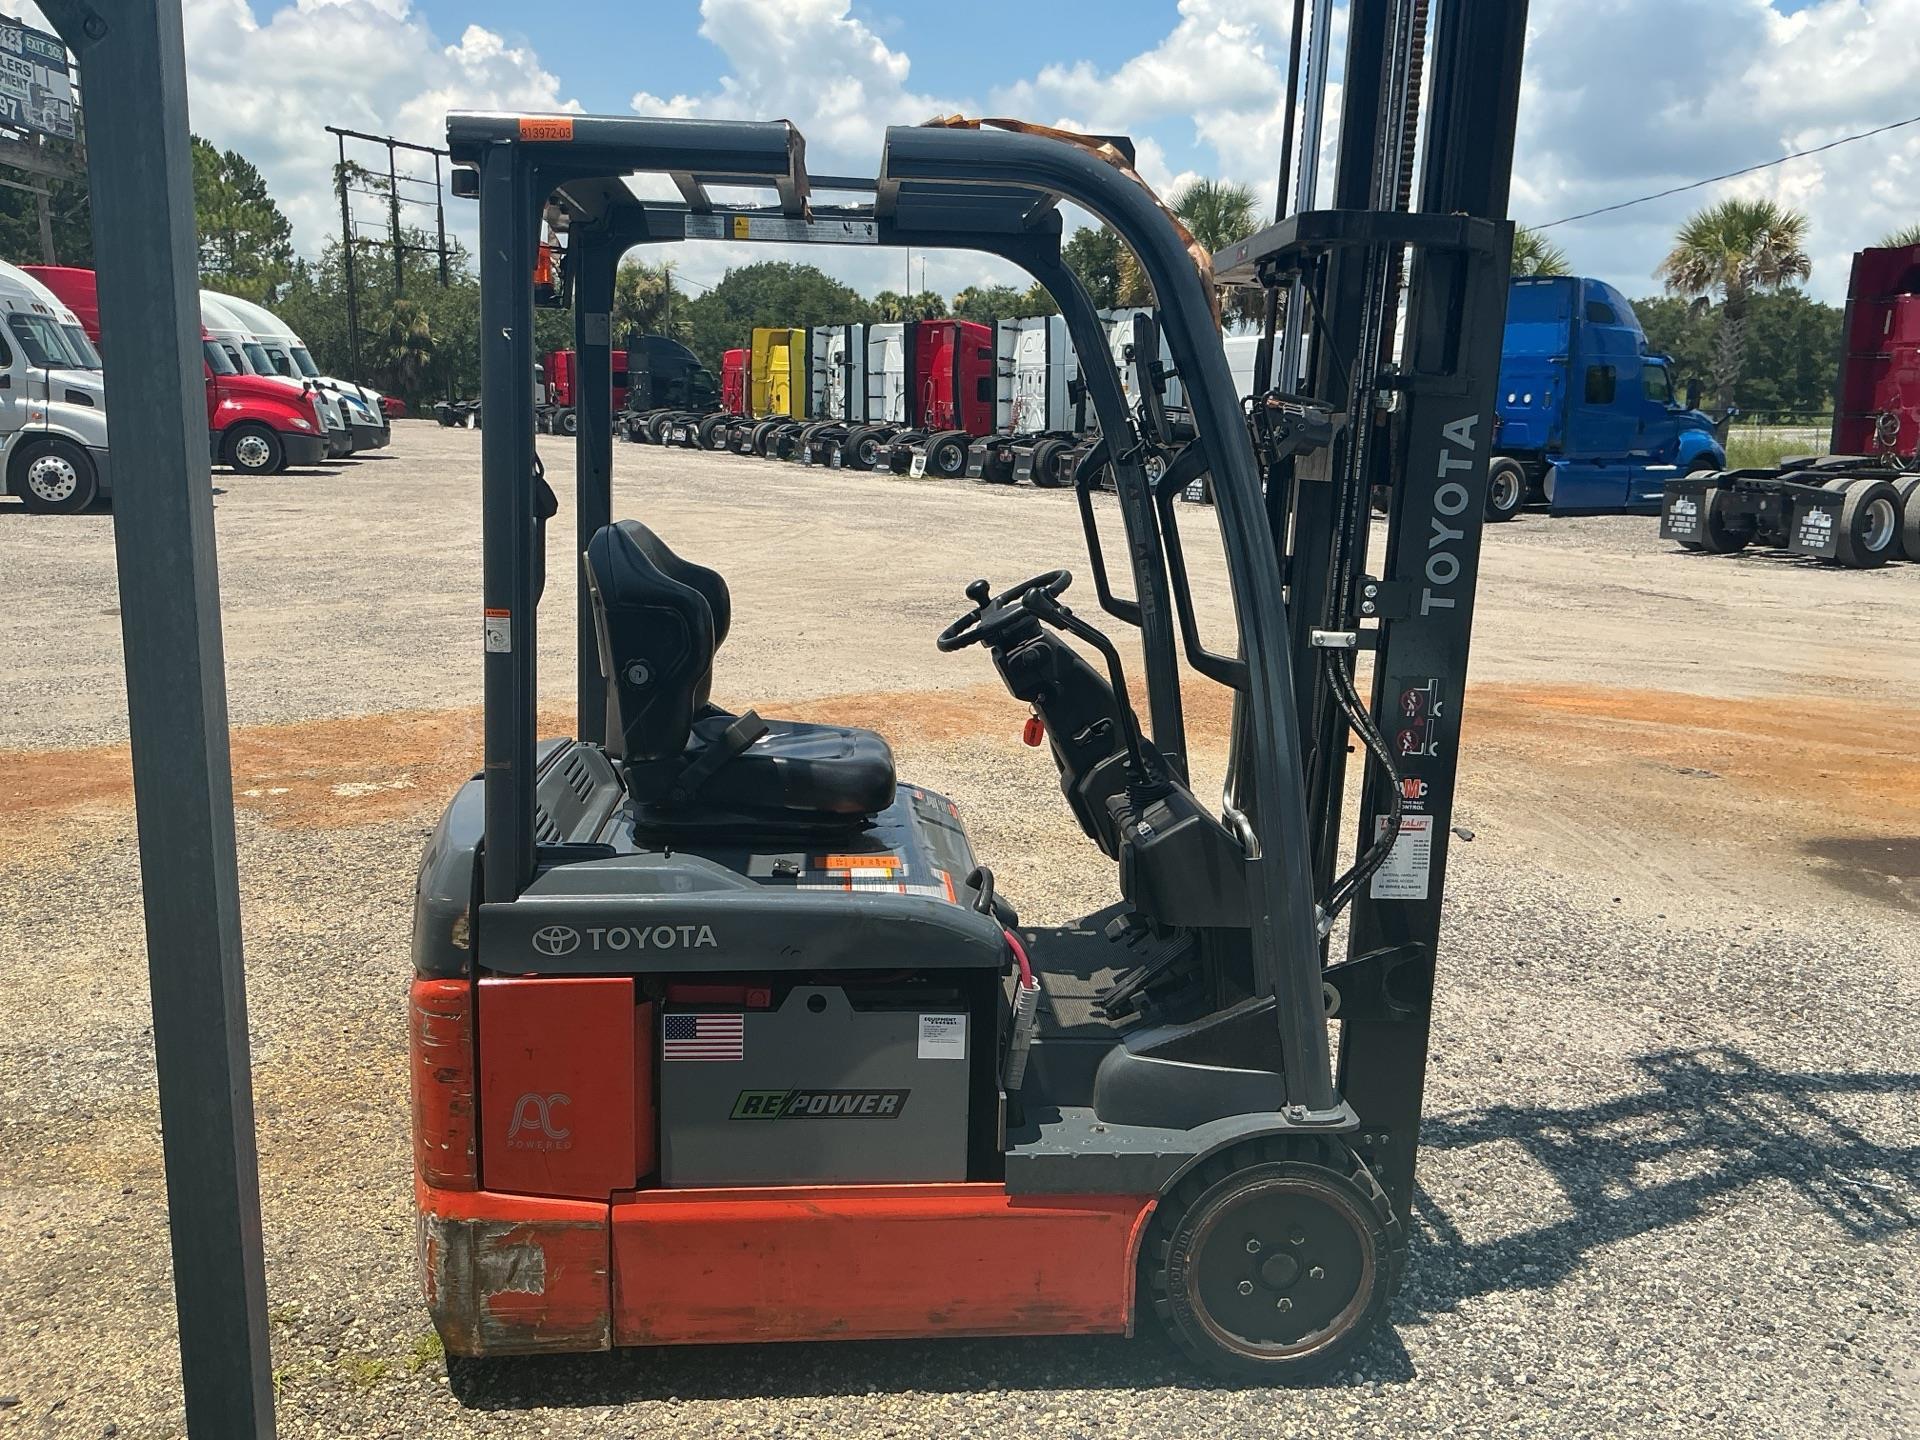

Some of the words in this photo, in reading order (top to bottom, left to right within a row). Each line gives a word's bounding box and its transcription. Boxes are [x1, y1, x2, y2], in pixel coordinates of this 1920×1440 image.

[26, 36, 46, 53] EXIT
[1420, 414, 1479, 616] TOYOTA
[587, 926, 717, 950] TOYOTA
[507, 1092, 571, 1139] AC
[507, 1140, 571, 1150] POWERED
